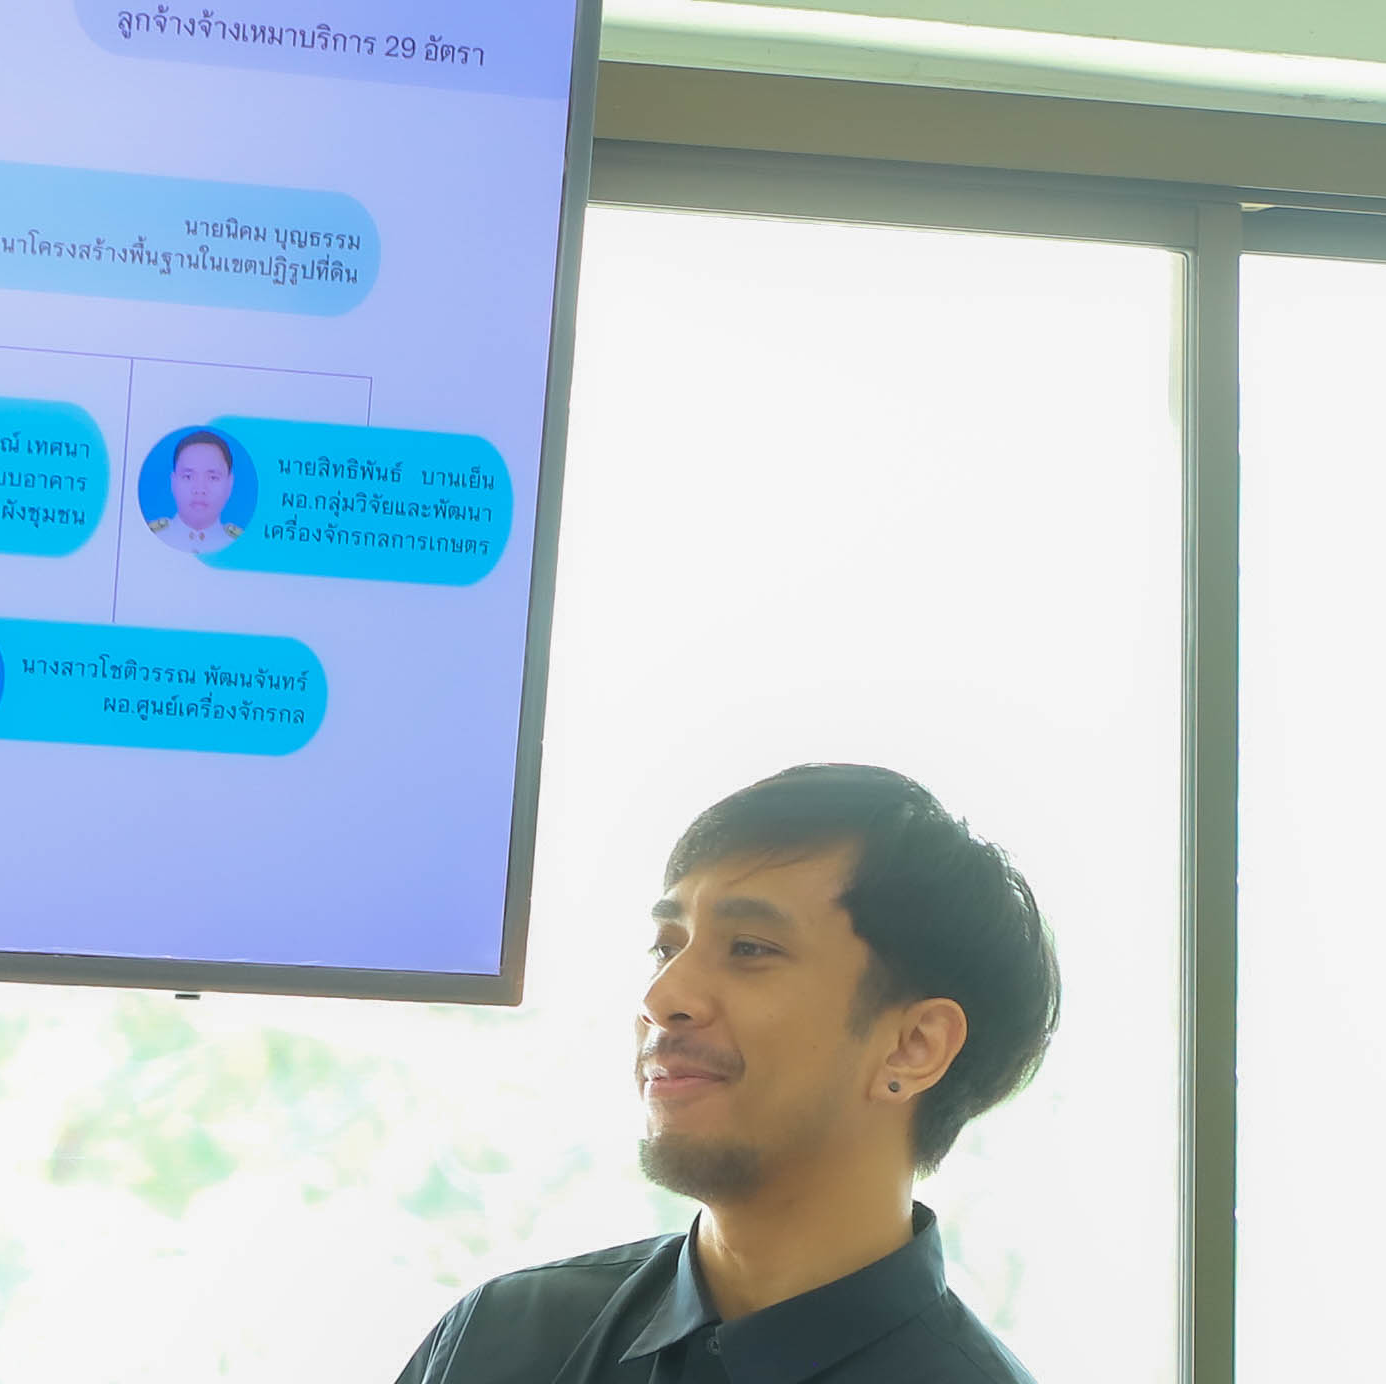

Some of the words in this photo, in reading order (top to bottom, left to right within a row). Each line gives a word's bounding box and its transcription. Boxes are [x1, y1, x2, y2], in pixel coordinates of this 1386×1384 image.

[117, 5, 376, 56] ลูกจ้างจ้างเหมาบริการ
[385, 36, 415, 59] 29
[424, 35, 485, 66] อัตรา
[185, 217, 267, 242] นายนิคม
[275, 227, 361, 252] บุญธรรม
[27, 438, 91, 459] เทศนา
[420, 465, 495, 491] บานเย็น
[281, 490, 493, 523] ผอ.กลุ่มวิจัยและพัฒนา
[264, 514, 491, 556] เครื่องจักรกลการเกษตร
[22, 653, 196, 685] นางสาวโชติวรรณ
[103, 692, 305, 725] ผอ.ศูนย์เครื่องจักรกล
